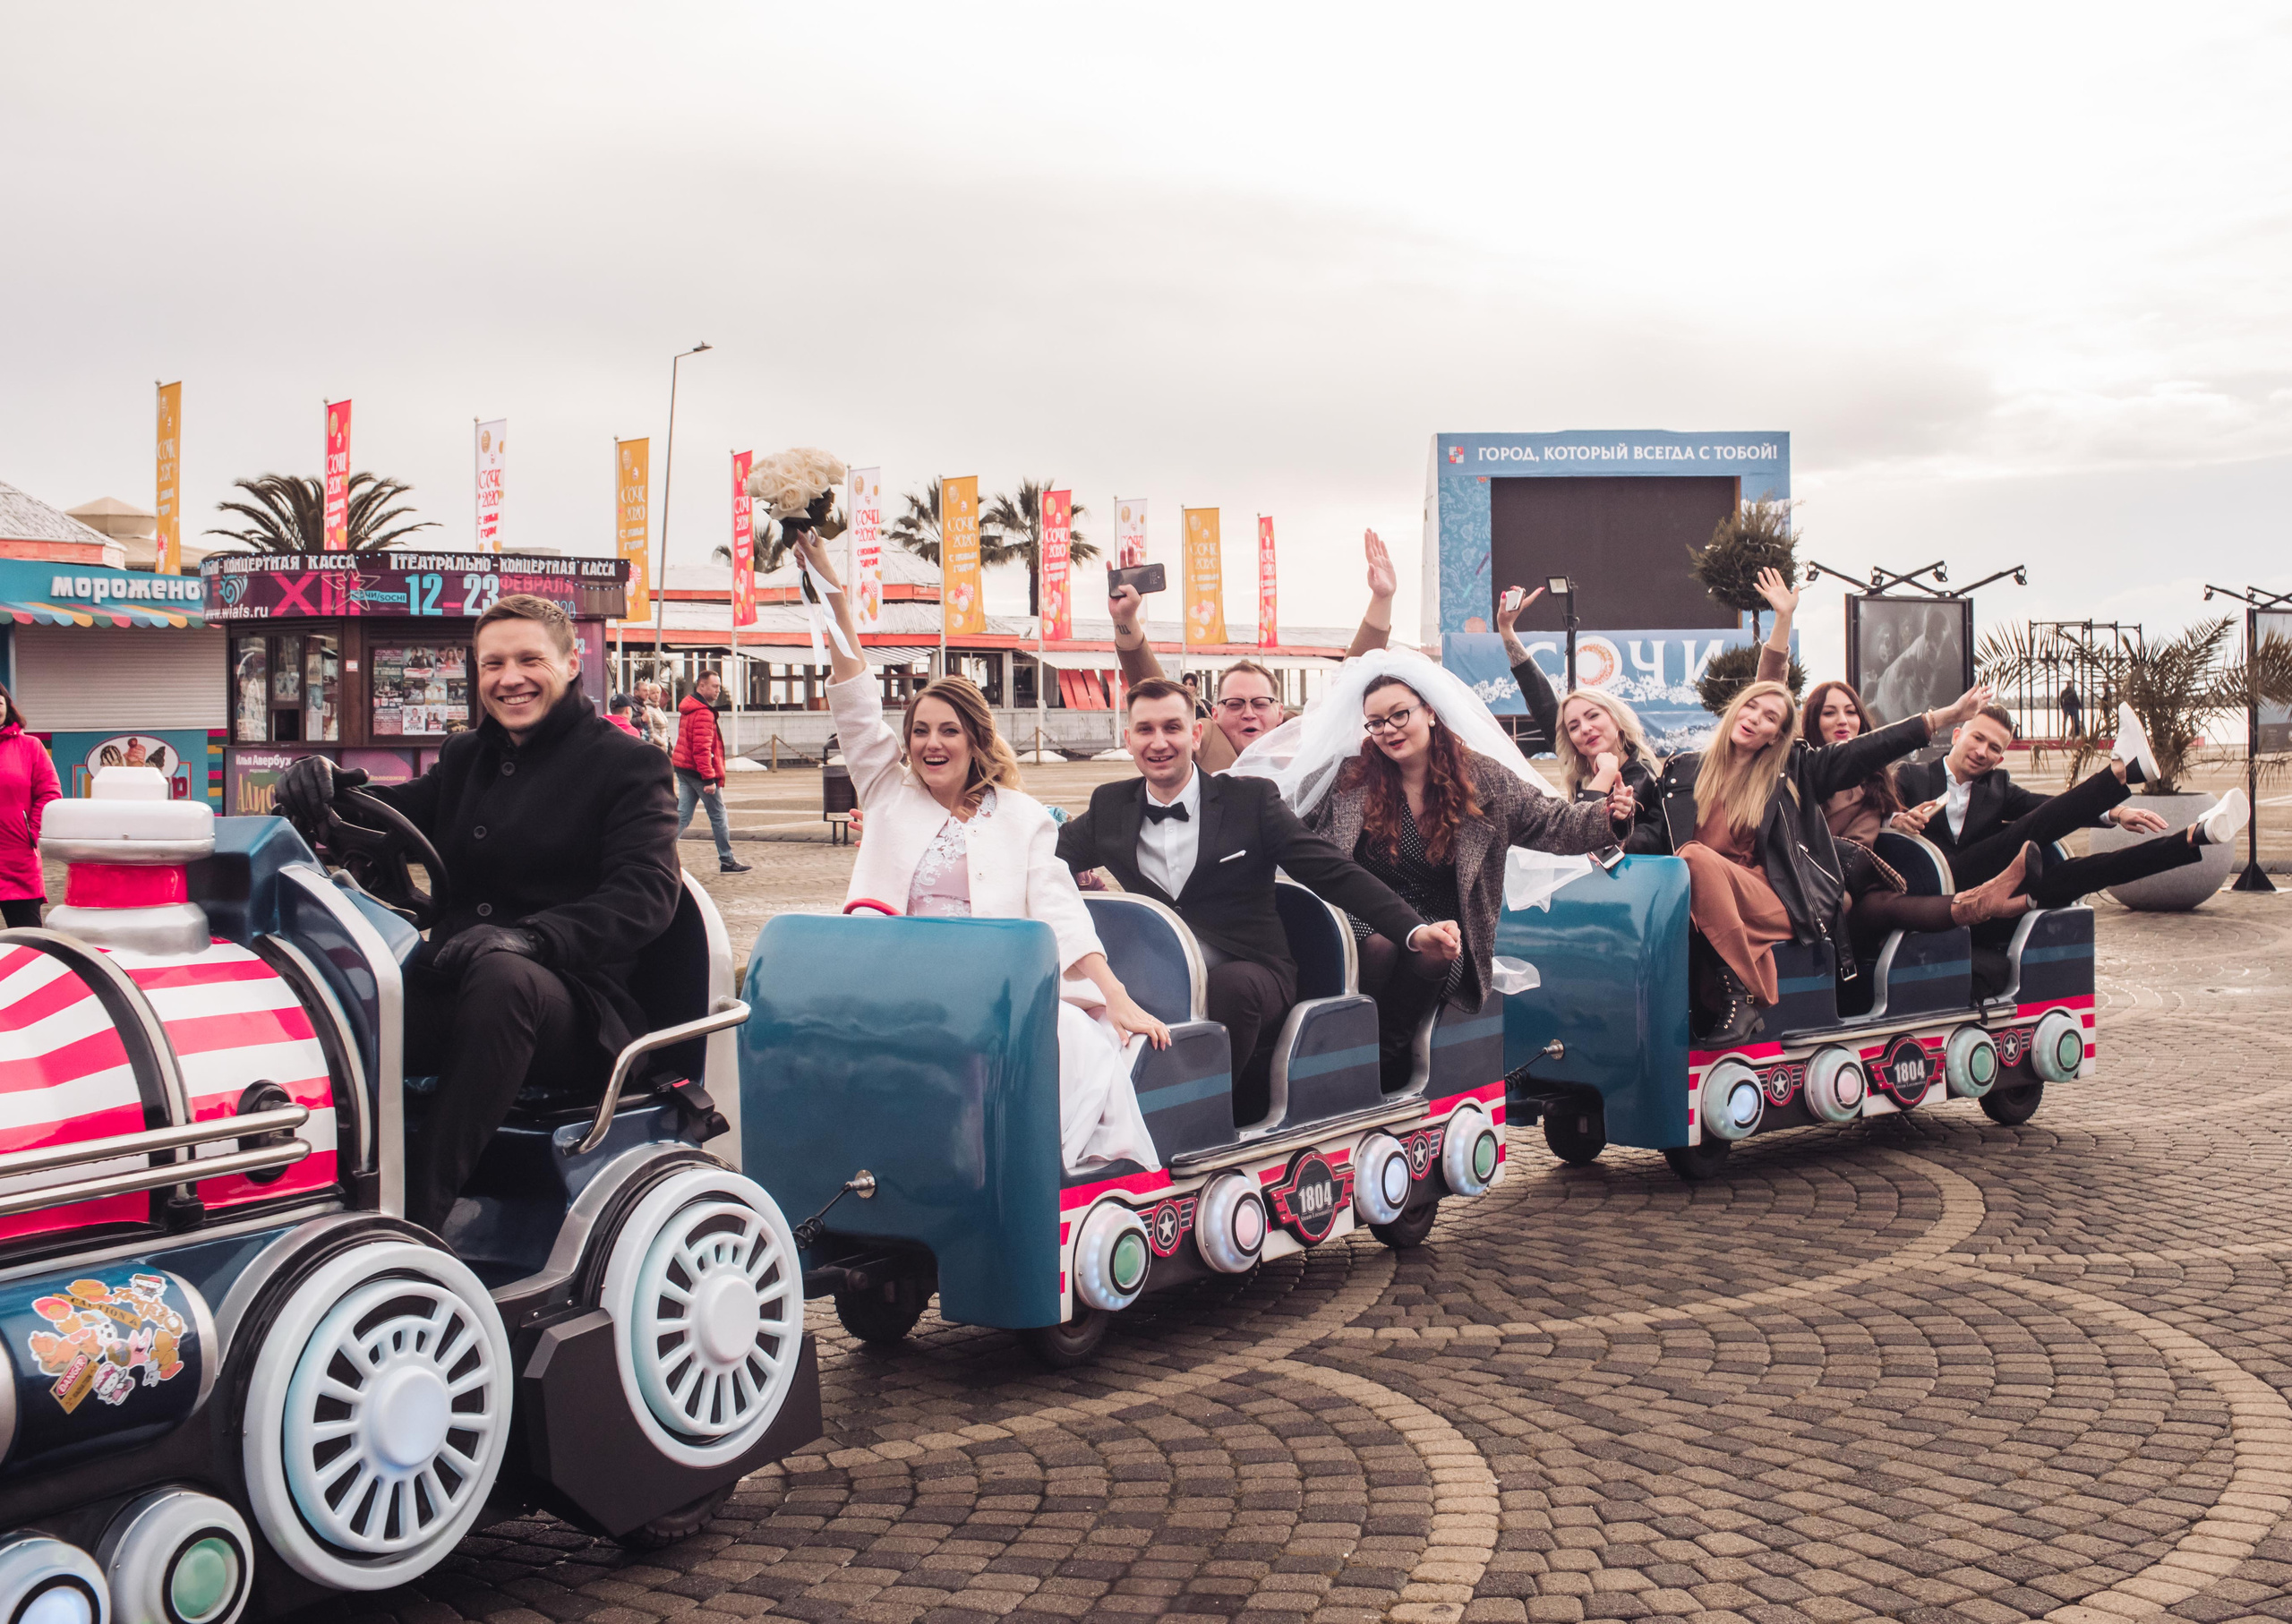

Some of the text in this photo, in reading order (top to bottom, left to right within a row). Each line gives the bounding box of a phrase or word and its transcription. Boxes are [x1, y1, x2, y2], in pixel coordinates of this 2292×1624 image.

[1478, 442, 1777, 462] ГОРОД, КОТОРЫЙ ВСЕГДА С ТОБОЙ!
[308, 554, 356, 569] КАССА
[581, 560, 616, 577] КАССА
[500, 576, 574, 594] ФЕВРАЛЯ
[235, 755, 292, 768] Илья Авербух
[1894, 1060, 1925, 1082] 1804
[1298, 1180, 1332, 1214] 1804
[71, 1297, 127, 1321] CAUTION
[58, 1357, 87, 1393] DANGER
